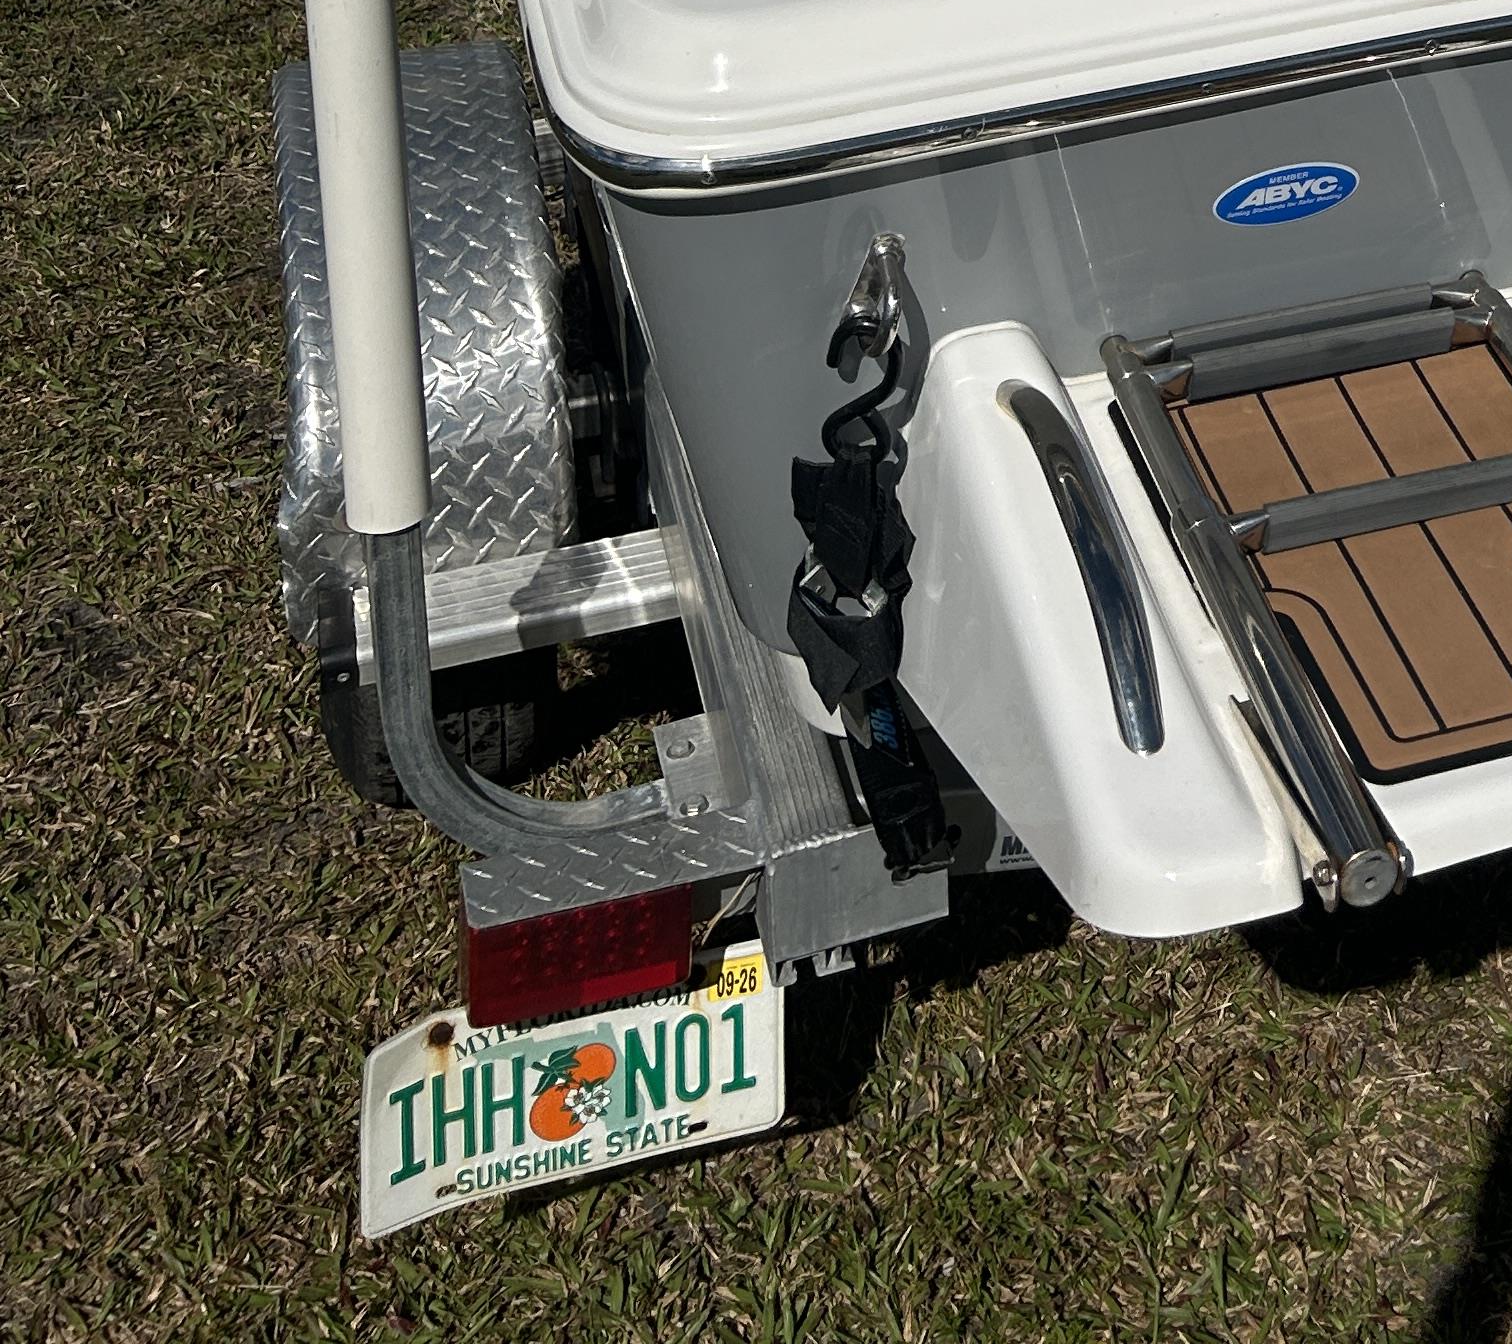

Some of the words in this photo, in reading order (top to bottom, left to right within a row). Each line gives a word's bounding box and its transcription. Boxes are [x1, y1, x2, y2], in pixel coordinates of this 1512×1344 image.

[1235, 175, 1338, 211] ABYC
[1269, 171, 1309, 184] MEMBER
[716, 966, 758, 998] 09-26
[389, 1054, 527, 1188] IHH
[454, 1138, 593, 1195] SUNSHINE
[606, 1113, 692, 1159] STATE
